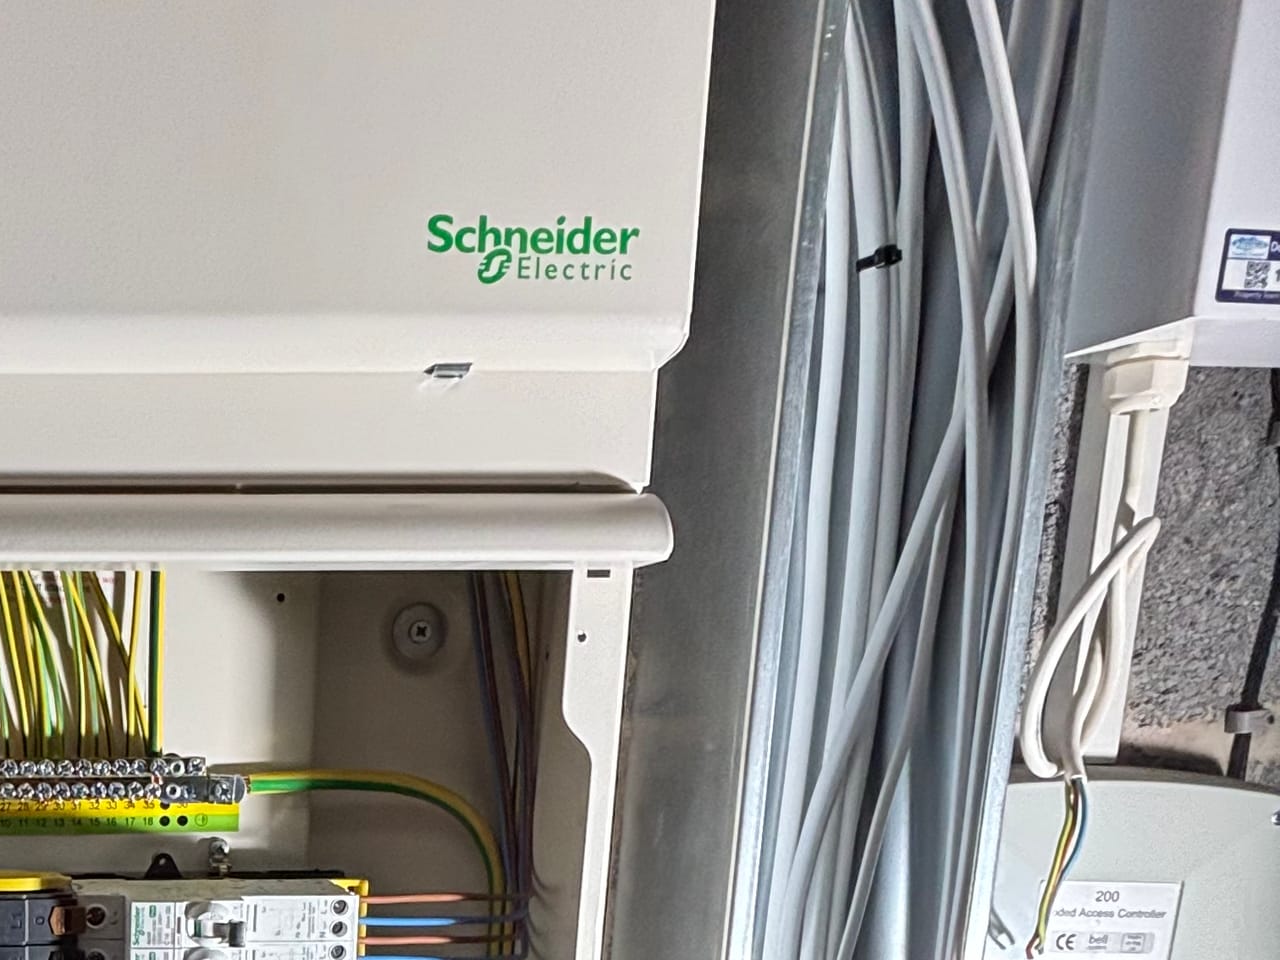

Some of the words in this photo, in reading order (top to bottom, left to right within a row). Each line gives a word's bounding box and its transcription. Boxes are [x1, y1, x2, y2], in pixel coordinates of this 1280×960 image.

[427, 214, 640, 255] Schneider
[517, 256, 632, 281] Electric
[0, 803, 11, 812] 27
[89, 801, 101, 810] 32
[106, 801, 118, 810] 33
[1095, 890, 1120, 903] 200
[1078, 908, 1115, 918] Access
[1117, 908, 1167, 919] Controller
